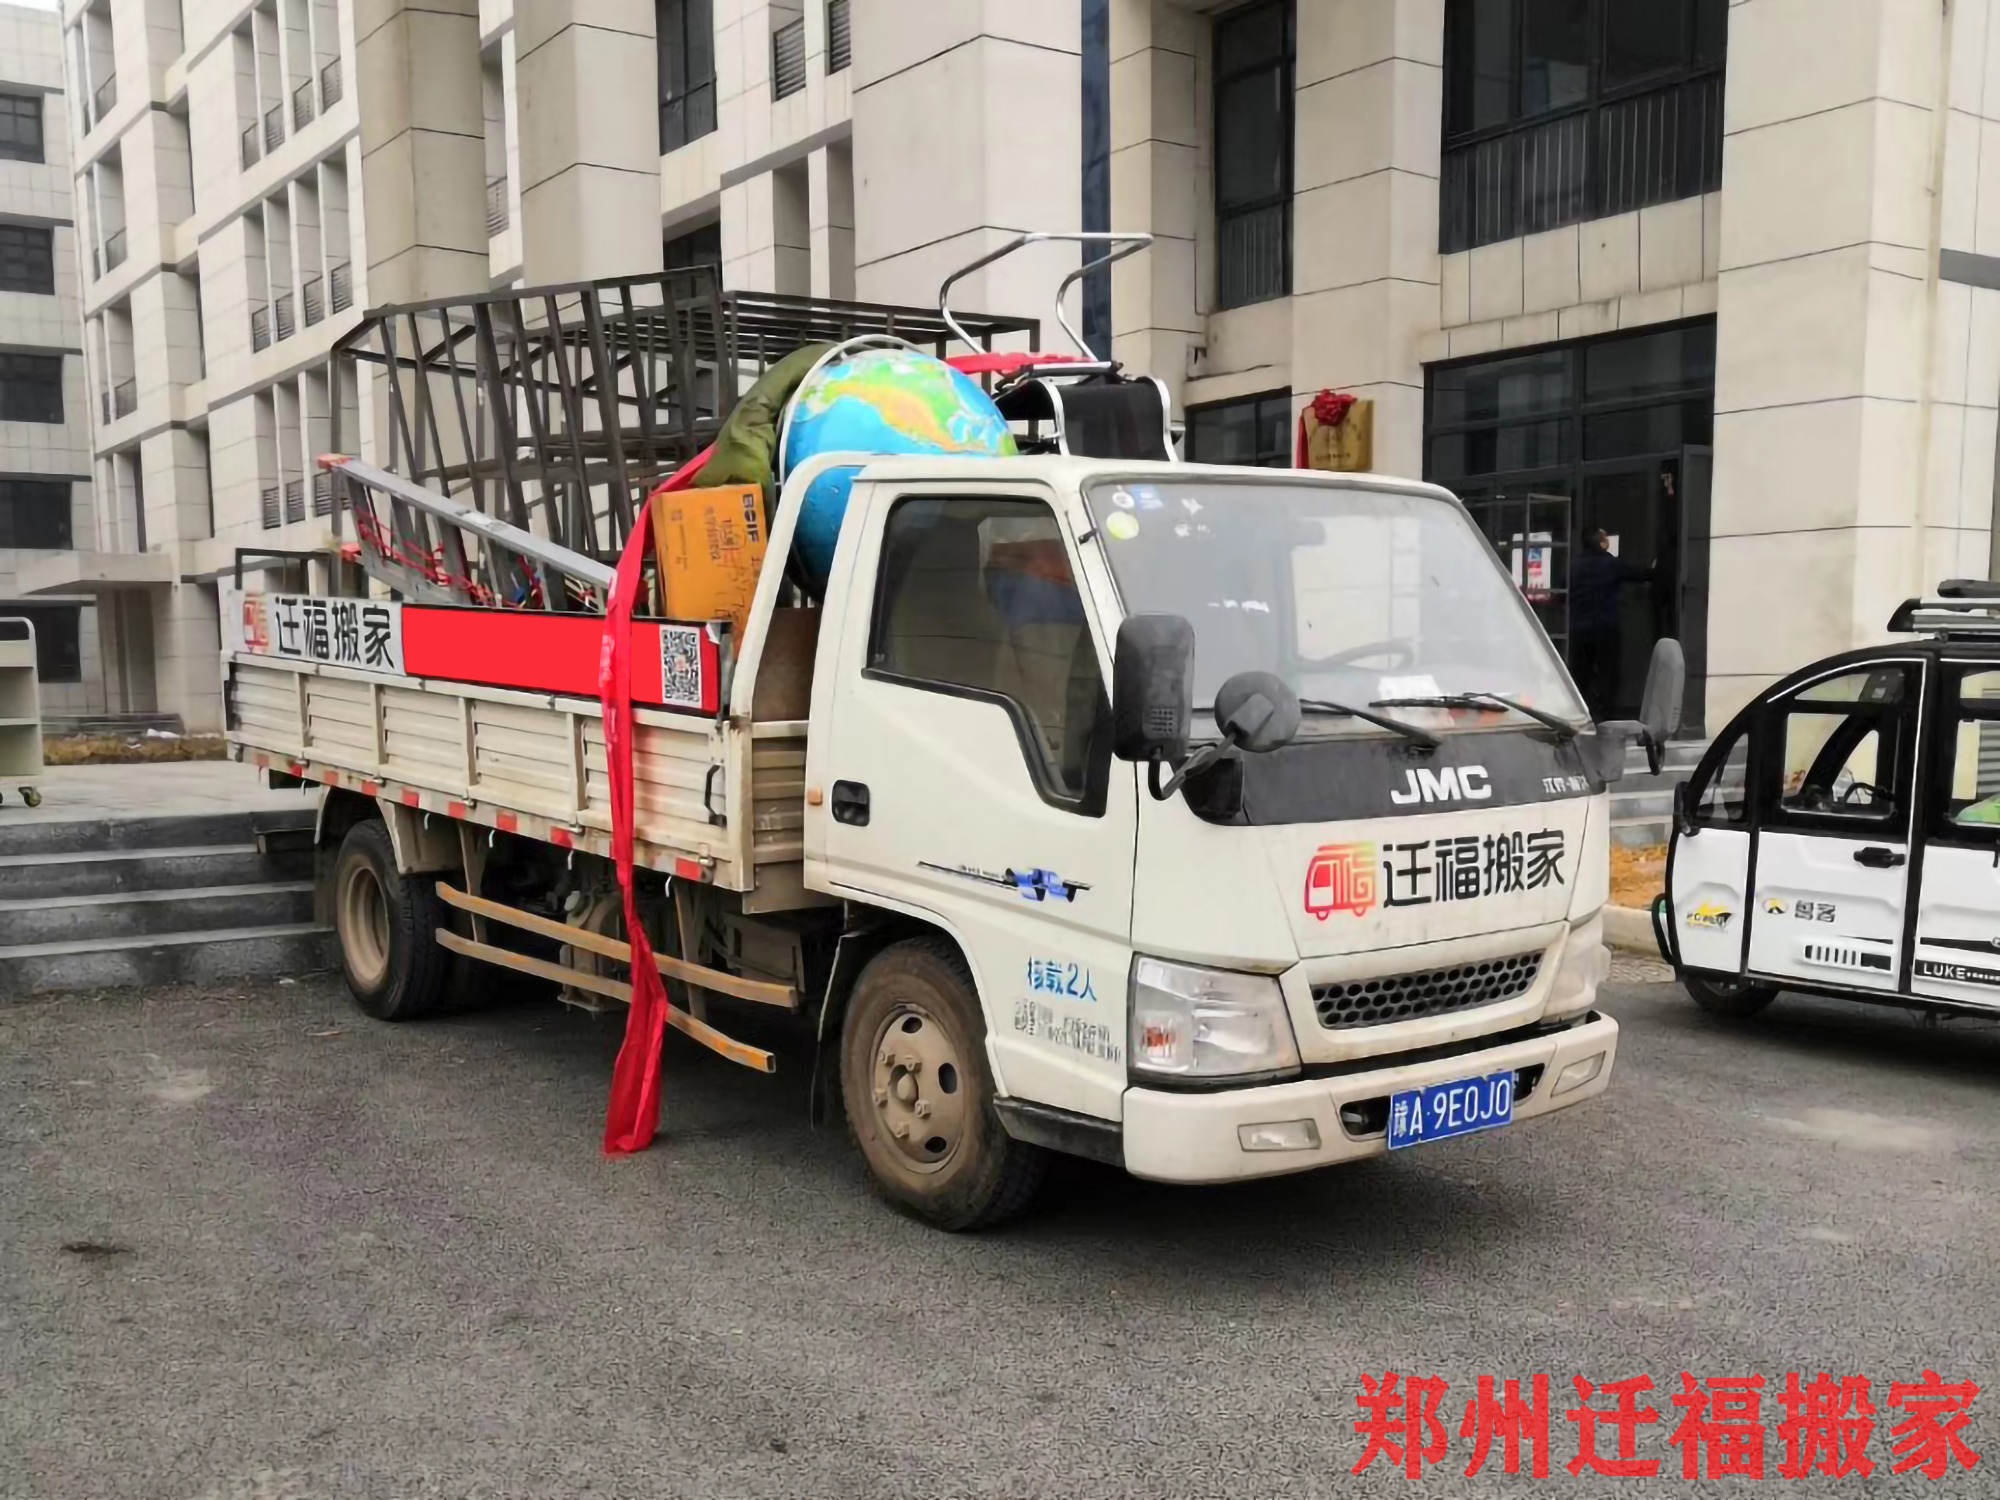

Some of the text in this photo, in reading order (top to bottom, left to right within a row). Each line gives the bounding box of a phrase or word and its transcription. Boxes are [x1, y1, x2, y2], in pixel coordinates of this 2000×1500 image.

[275, 596, 395, 669] 迁福搬家
[1390, 764, 1492, 805] JMC
[1382, 828, 1565, 909] 迁福搬家
[1923, 962, 1967, 980] LUKE
